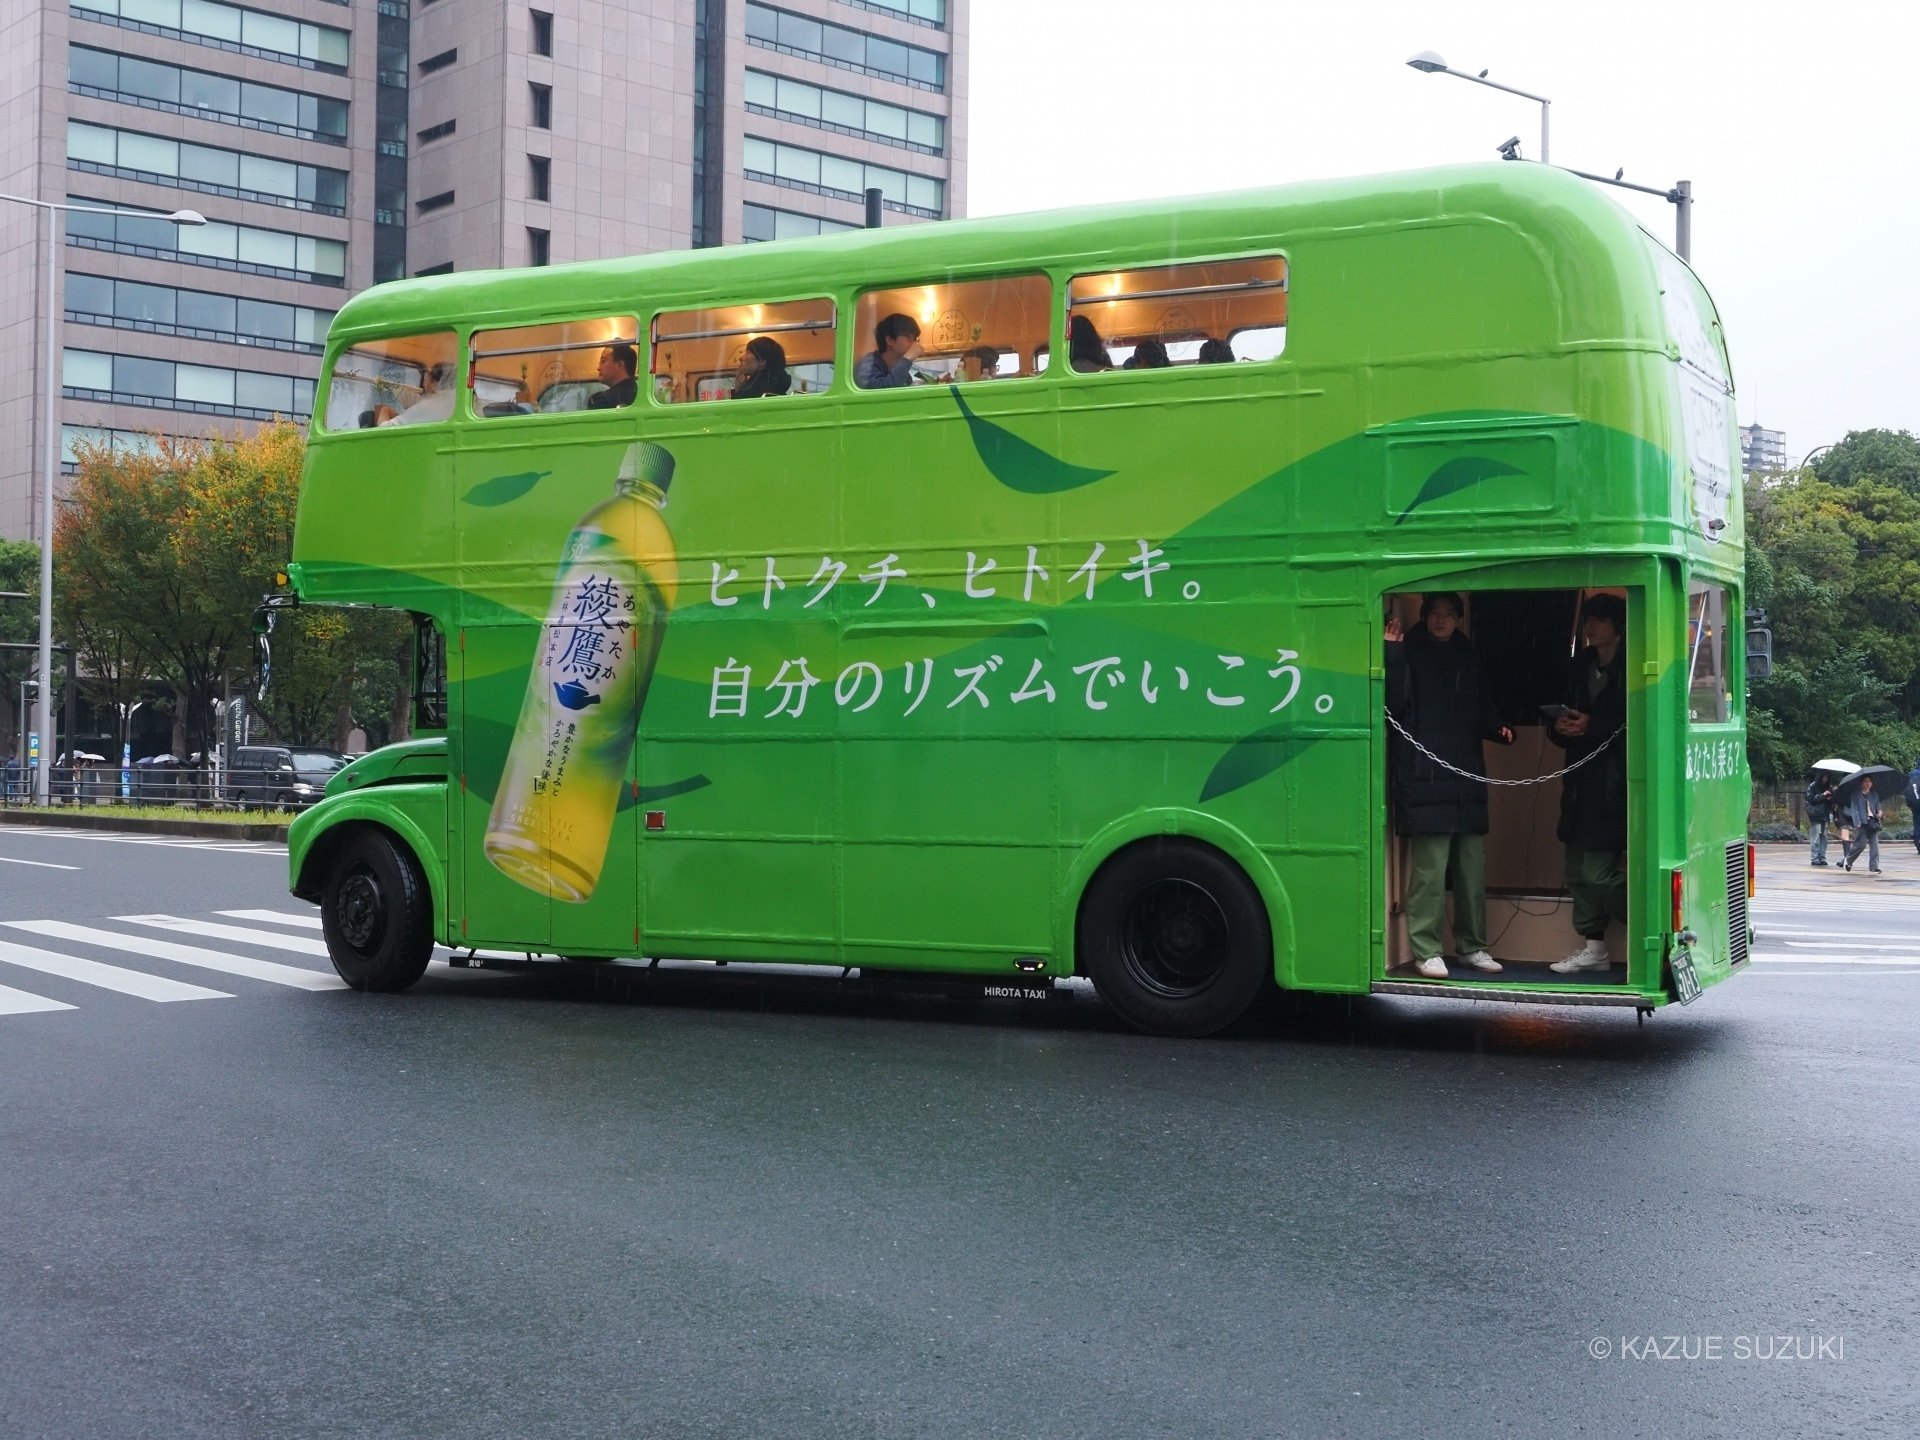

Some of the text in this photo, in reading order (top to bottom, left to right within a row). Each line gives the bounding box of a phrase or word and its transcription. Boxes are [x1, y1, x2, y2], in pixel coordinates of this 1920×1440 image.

[709, 539, 1201, 609] ヒトクチ、ヒトイキ。
[556, 573, 619, 681] 綾鷹
[600, 594, 636, 680] あやたか
[708, 648, 1335, 719] 自分のリズムでいこう。
[551, 722, 577, 797] 豊かなうまみと
[512, 801, 574, 834] AUTHTIC
[984, 986, 1046, 1000] HIROTA TAXI
